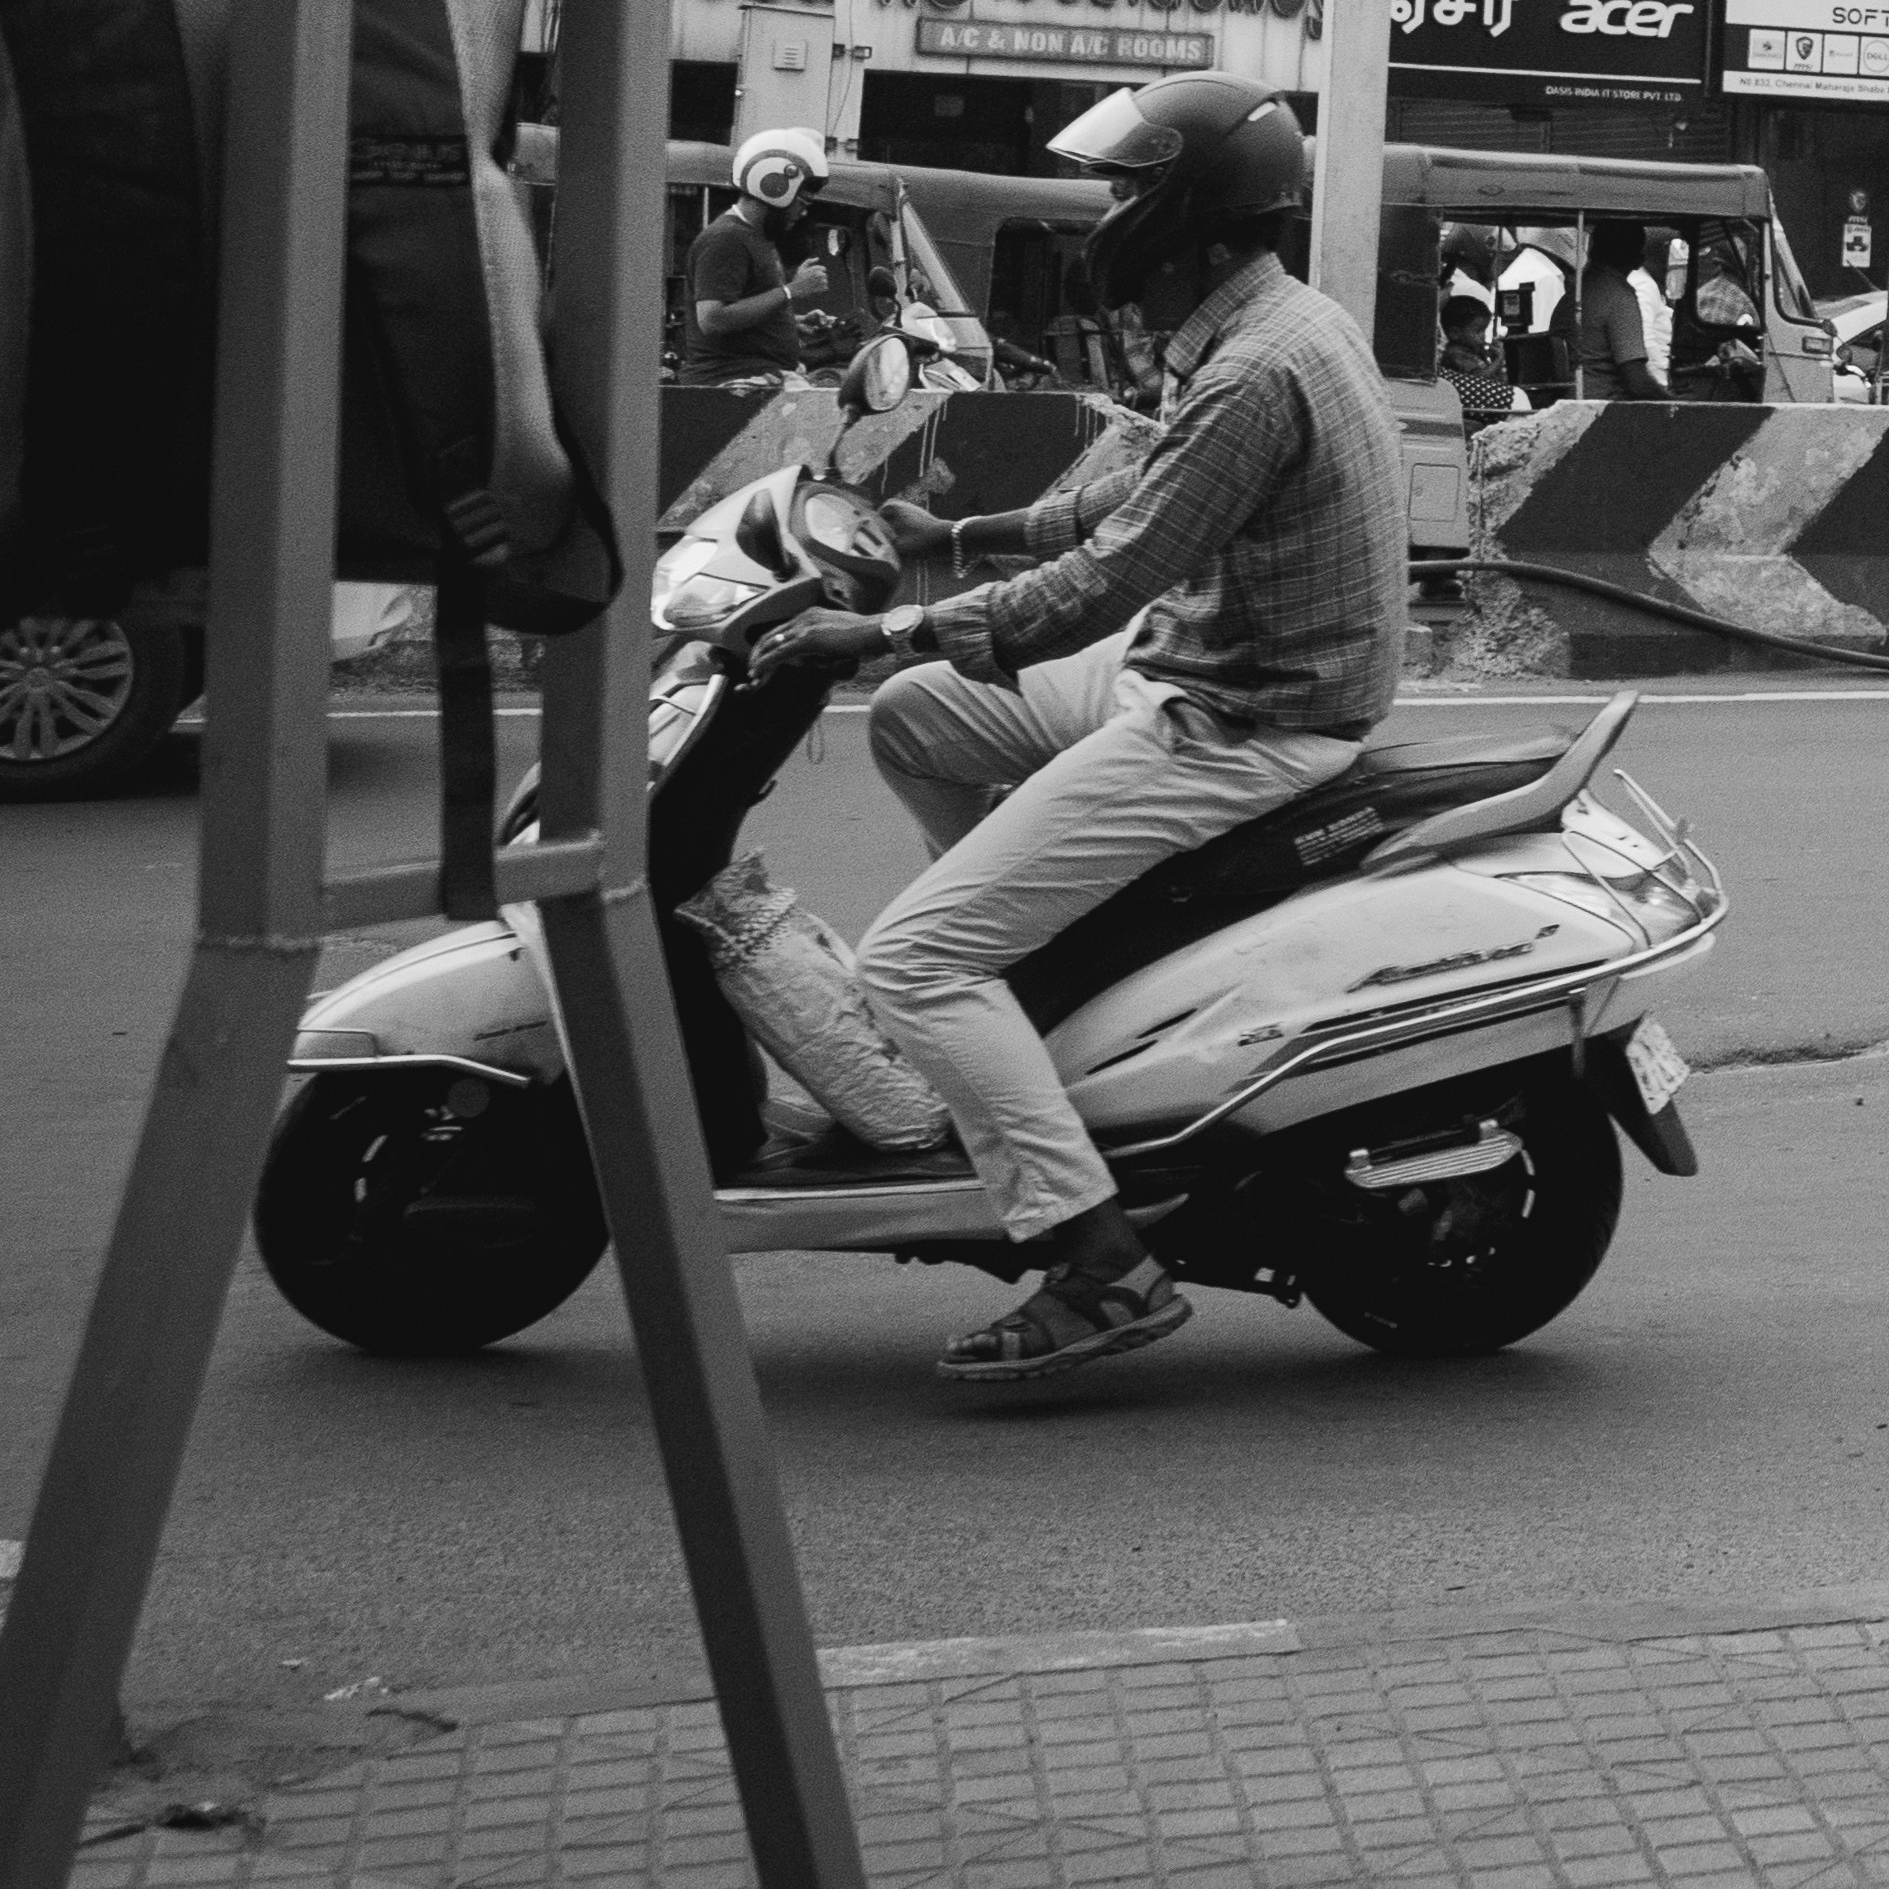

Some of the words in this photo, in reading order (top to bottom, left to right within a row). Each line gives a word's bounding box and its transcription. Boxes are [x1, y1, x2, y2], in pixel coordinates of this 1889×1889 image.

[939, 26, 978, 48] A/C
[987, 30, 1006, 50] &
[1013, 30, 1062, 53] NON
[1070, 34, 1109, 56] A/C
[1116, 38, 1201, 61] ROOMS
[1545, 85, 1573, 96] OASIS
